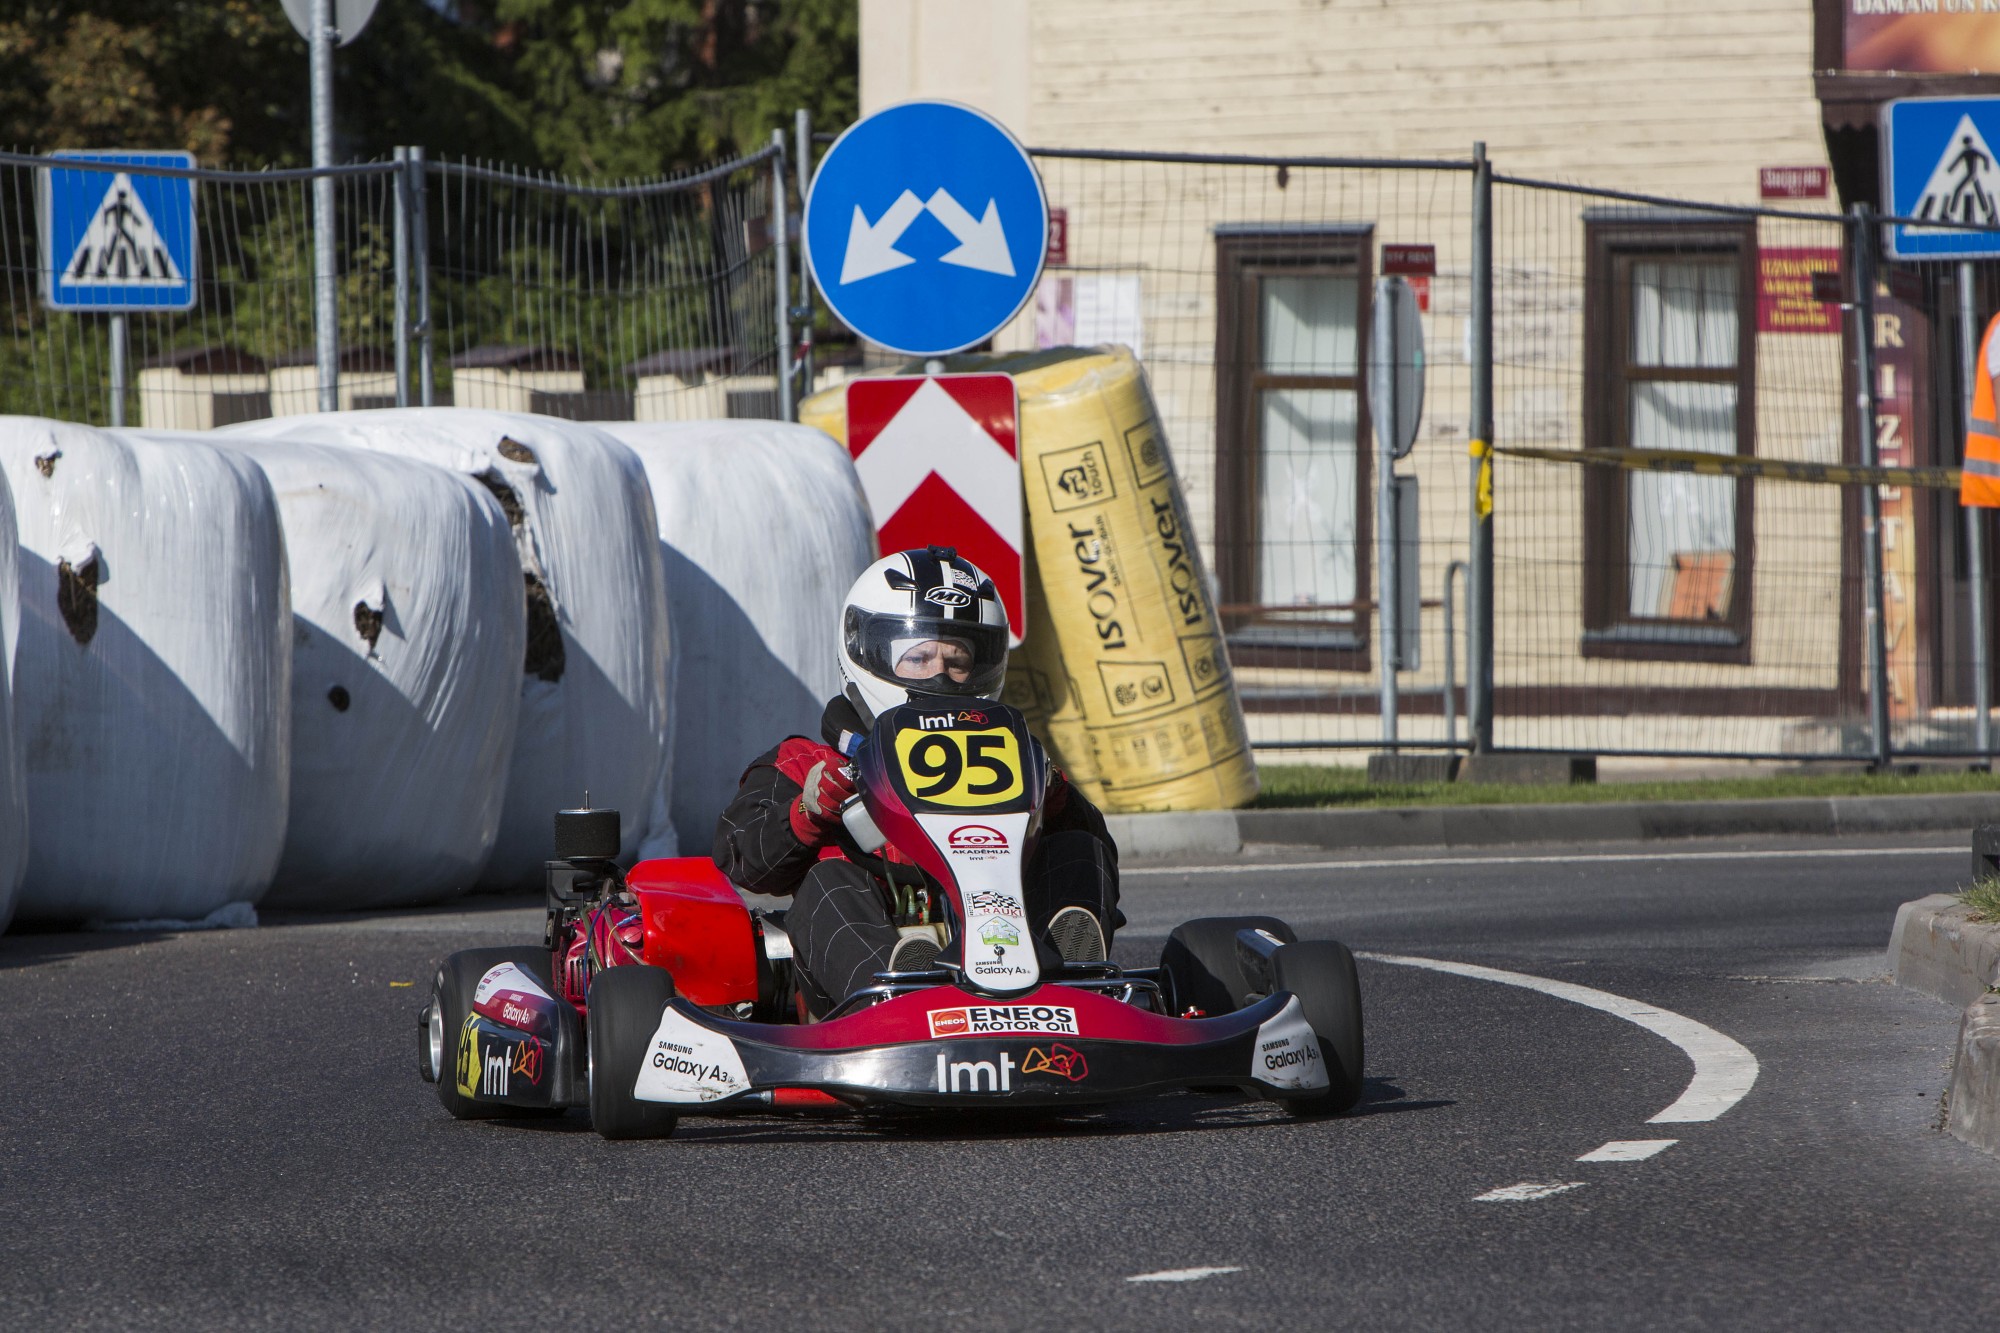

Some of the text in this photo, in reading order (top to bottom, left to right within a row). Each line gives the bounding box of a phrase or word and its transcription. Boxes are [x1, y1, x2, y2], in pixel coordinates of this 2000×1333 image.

[1981, 0, 2000, 14] K
[918, 713, 955, 730] lmt
[908, 733, 1014, 798] 95
[975, 966, 1013, 976] Galaxy
[934, 1006, 1073, 1027] ENEOS ENEOS
[973, 1021, 1075, 1033] MOTOR OIL
[658, 1040, 693, 1055] SAMSUNG
[1262, 1038, 1290, 1052] SAMSUNG
[653, 1052, 709, 1082] Galaxy
[1265, 1049, 1305, 1070] Galaxy
[483, 1044, 512, 1096] lmt
[936, 1052, 1016, 1092] lmt
